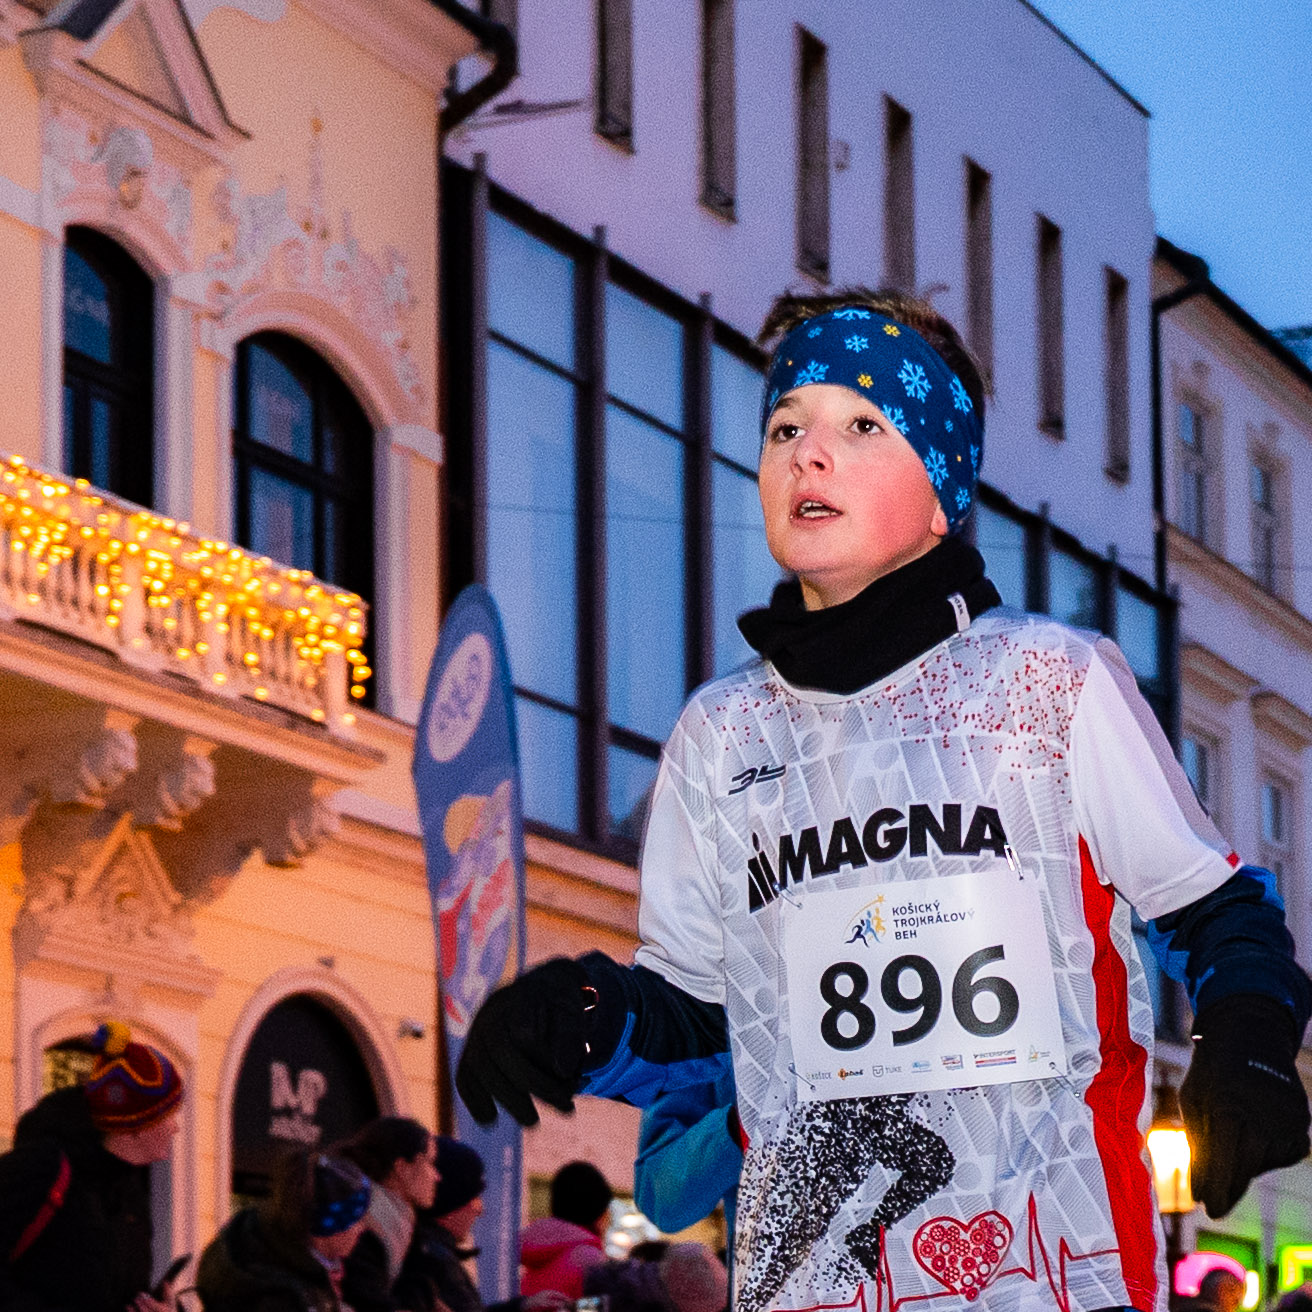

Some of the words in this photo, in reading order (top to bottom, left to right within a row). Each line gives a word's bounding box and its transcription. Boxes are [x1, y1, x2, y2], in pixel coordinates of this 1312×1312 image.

[778, 803, 1008, 891] MAGNA
[892, 899, 941, 917] KOŠICKÝ
[893, 907, 976, 928] TROJKRÁĽOVÝ
[895, 929, 918, 941] BEH
[819, 945, 1020, 1051] 896
[978, 1049, 1016, 1059] INTERSPORT
